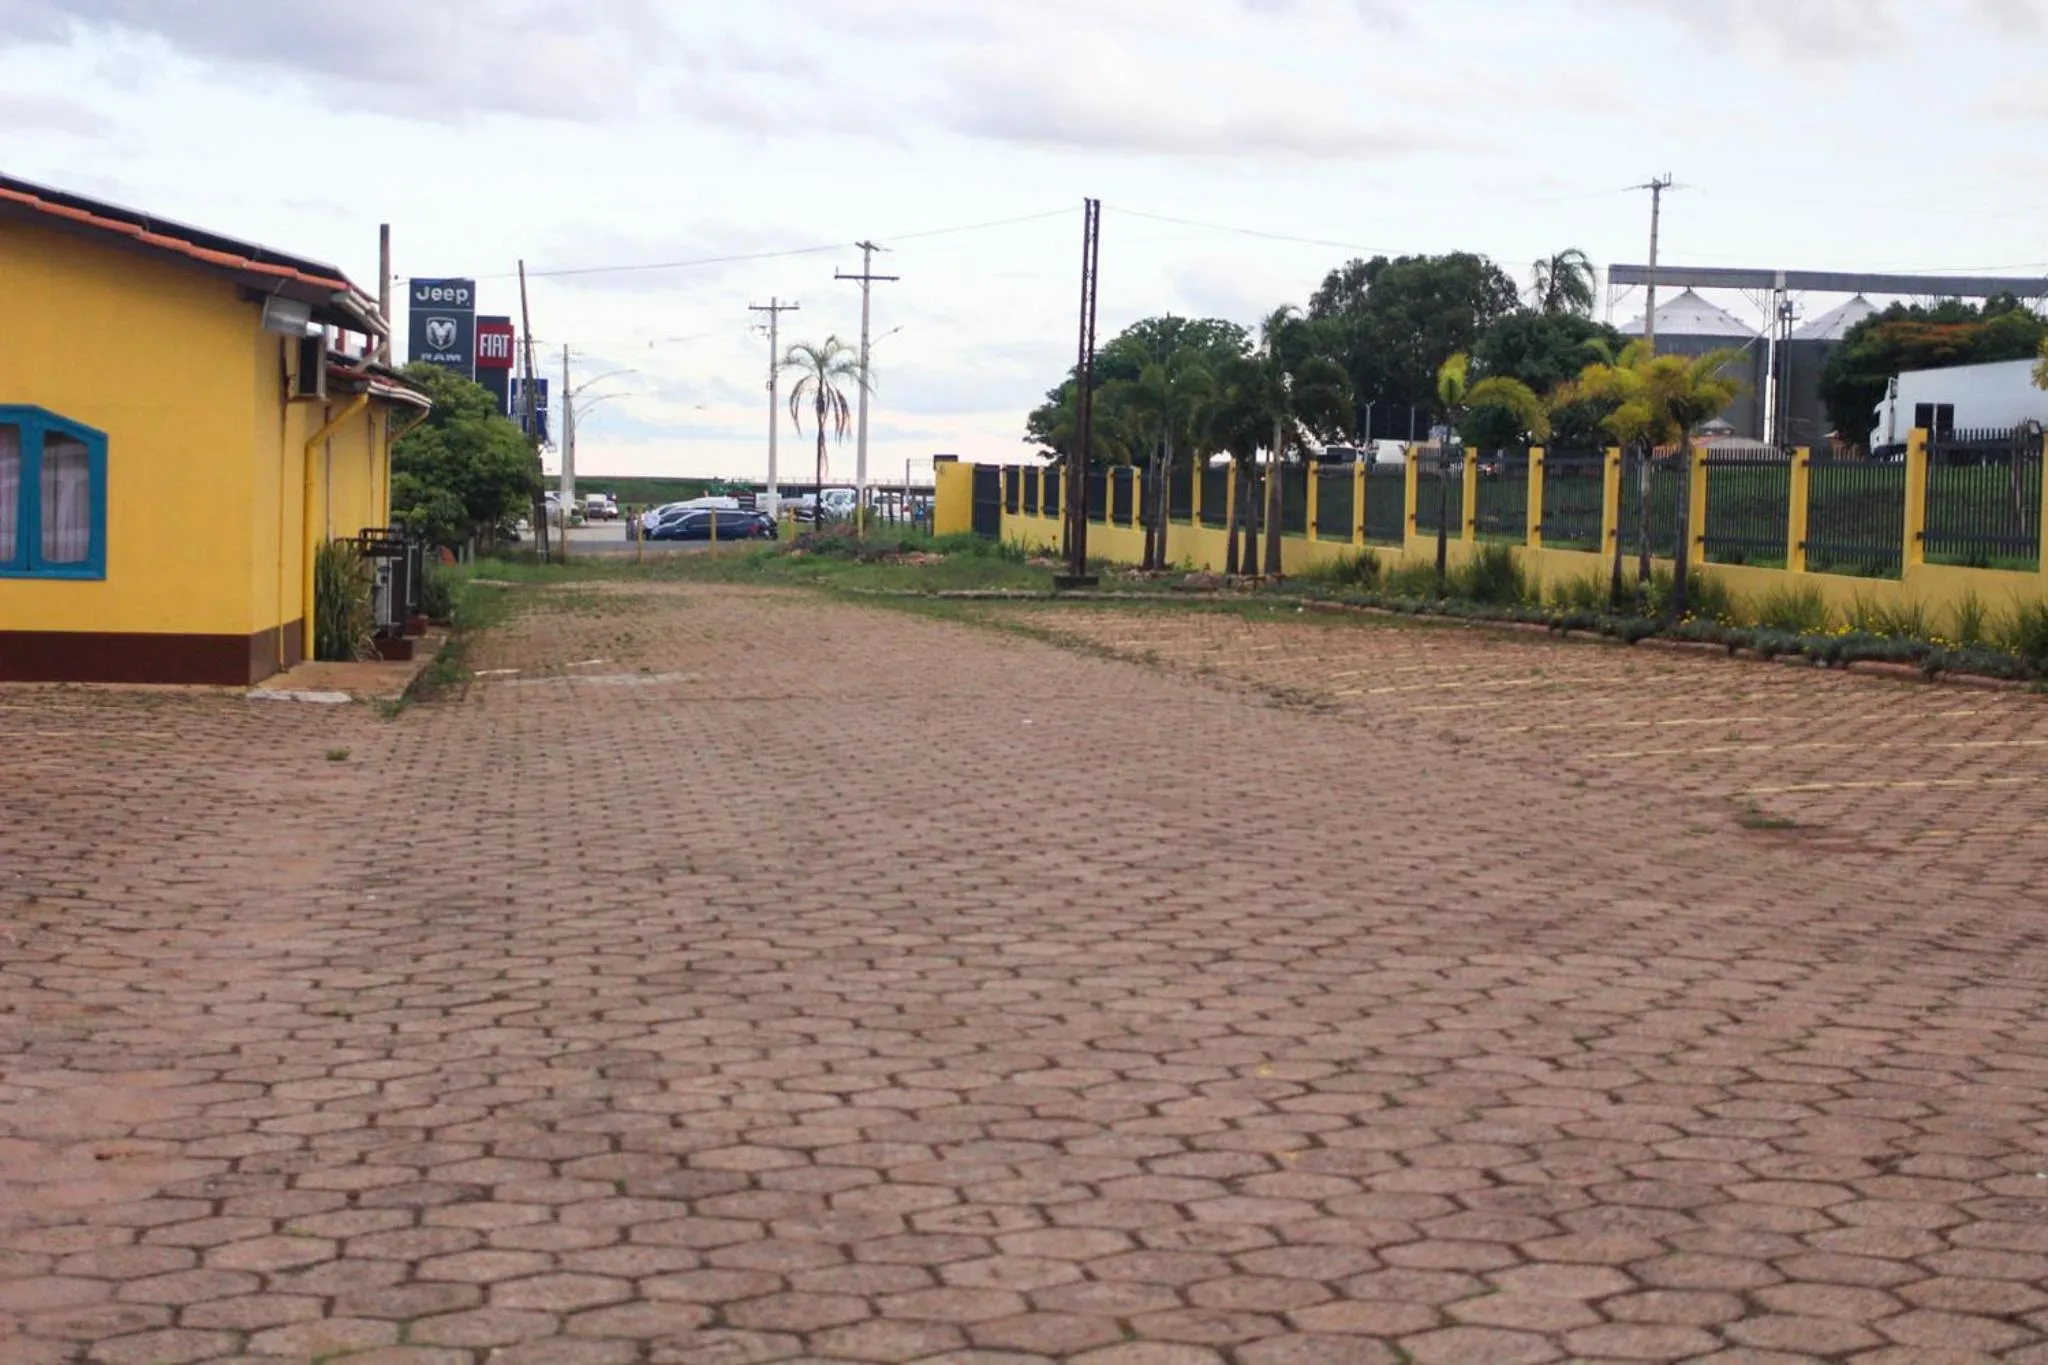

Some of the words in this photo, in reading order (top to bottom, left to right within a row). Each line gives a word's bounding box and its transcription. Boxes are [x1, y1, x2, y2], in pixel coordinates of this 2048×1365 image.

[416, 286, 468, 305] Jeep
[480, 333, 510, 357] FIAT
[420, 353, 462, 362] RAM
